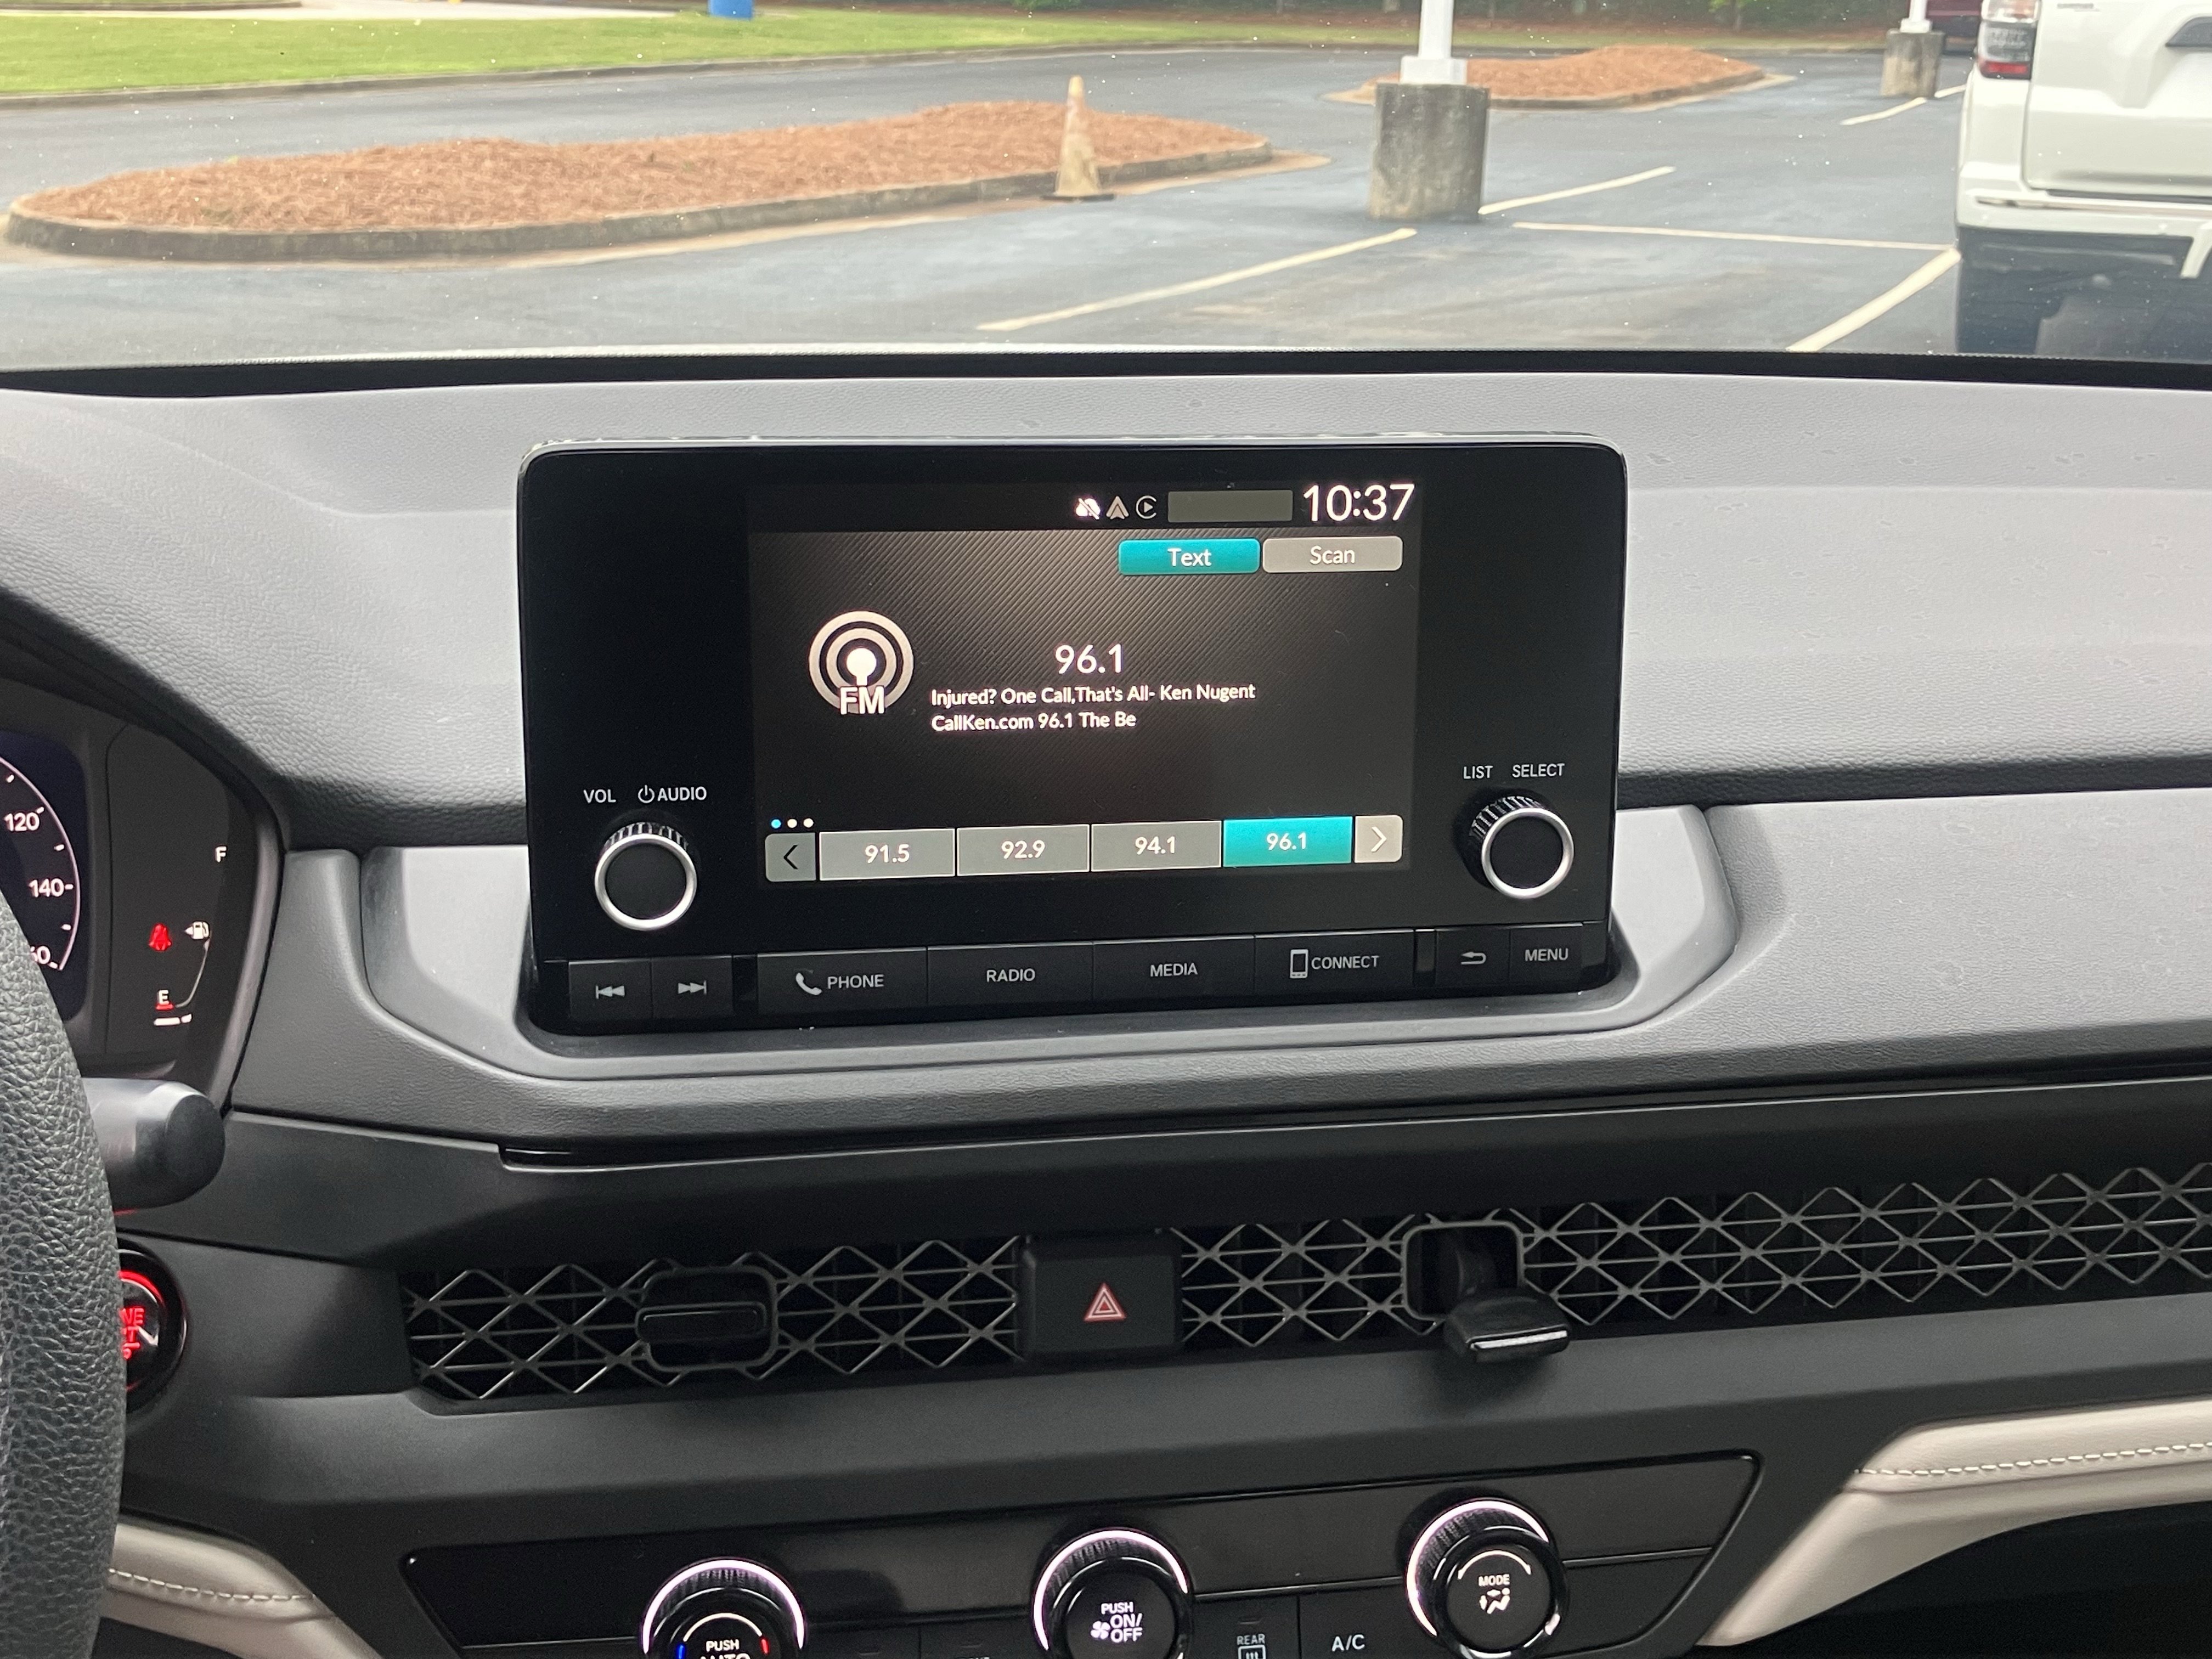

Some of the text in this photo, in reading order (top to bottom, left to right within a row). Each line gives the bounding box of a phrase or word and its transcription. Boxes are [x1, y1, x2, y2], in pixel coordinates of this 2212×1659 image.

[1303, 483, 1415, 522] 10:37
[1167, 548, 1212, 567] Text
[1310, 545, 1356, 565] Scan
[1054, 643, 1122, 675] 96.1
[839, 686, 885, 715] FM
[931, 689, 997, 709] Injured?
[1000, 687, 1037, 705] One
[1126, 684, 1156, 702] All-
[1160, 684, 1193, 701] Ken
[1196, 683, 1256, 703] Nugent
[931, 710, 1137, 732] CallKen.com 96.1 The Be
[1463, 765, 1493, 779] LIST
[1512, 763, 1565, 778] SELECT
[583, 789, 617, 804] VOL
[657, 786, 707, 802] AUDIO
[4, 812, 40, 832] 120
[1135, 836, 1176, 855] 94.1
[1266, 831, 1307, 851] 96.1
[215, 846, 227, 862] F
[864, 843, 910, 864] 91.5
[1001, 839, 1046, 860] 92.9
[29, 878, 65, 898] 140
[1311, 955, 1380, 970] CONNECT
[1525, 947, 1569, 962] MENU
[986, 968, 1036, 983] RADIO
[1150, 962, 1199, 977] MEDIA
[827, 974, 884, 990] PHONE
[157, 989, 169, 1004] E
[1478, 1574, 1510, 1587] MODE
[1101, 1601, 1133, 1615] PUSH
[1110, 1613, 1143, 1628] ON/
[1110, 1627, 1143, 1643] OFF
[1237, 1633, 1266, 1646] REAR
[1331, 1634, 1366, 1652] A/C
[706, 1639, 740, 1652] PUSH
